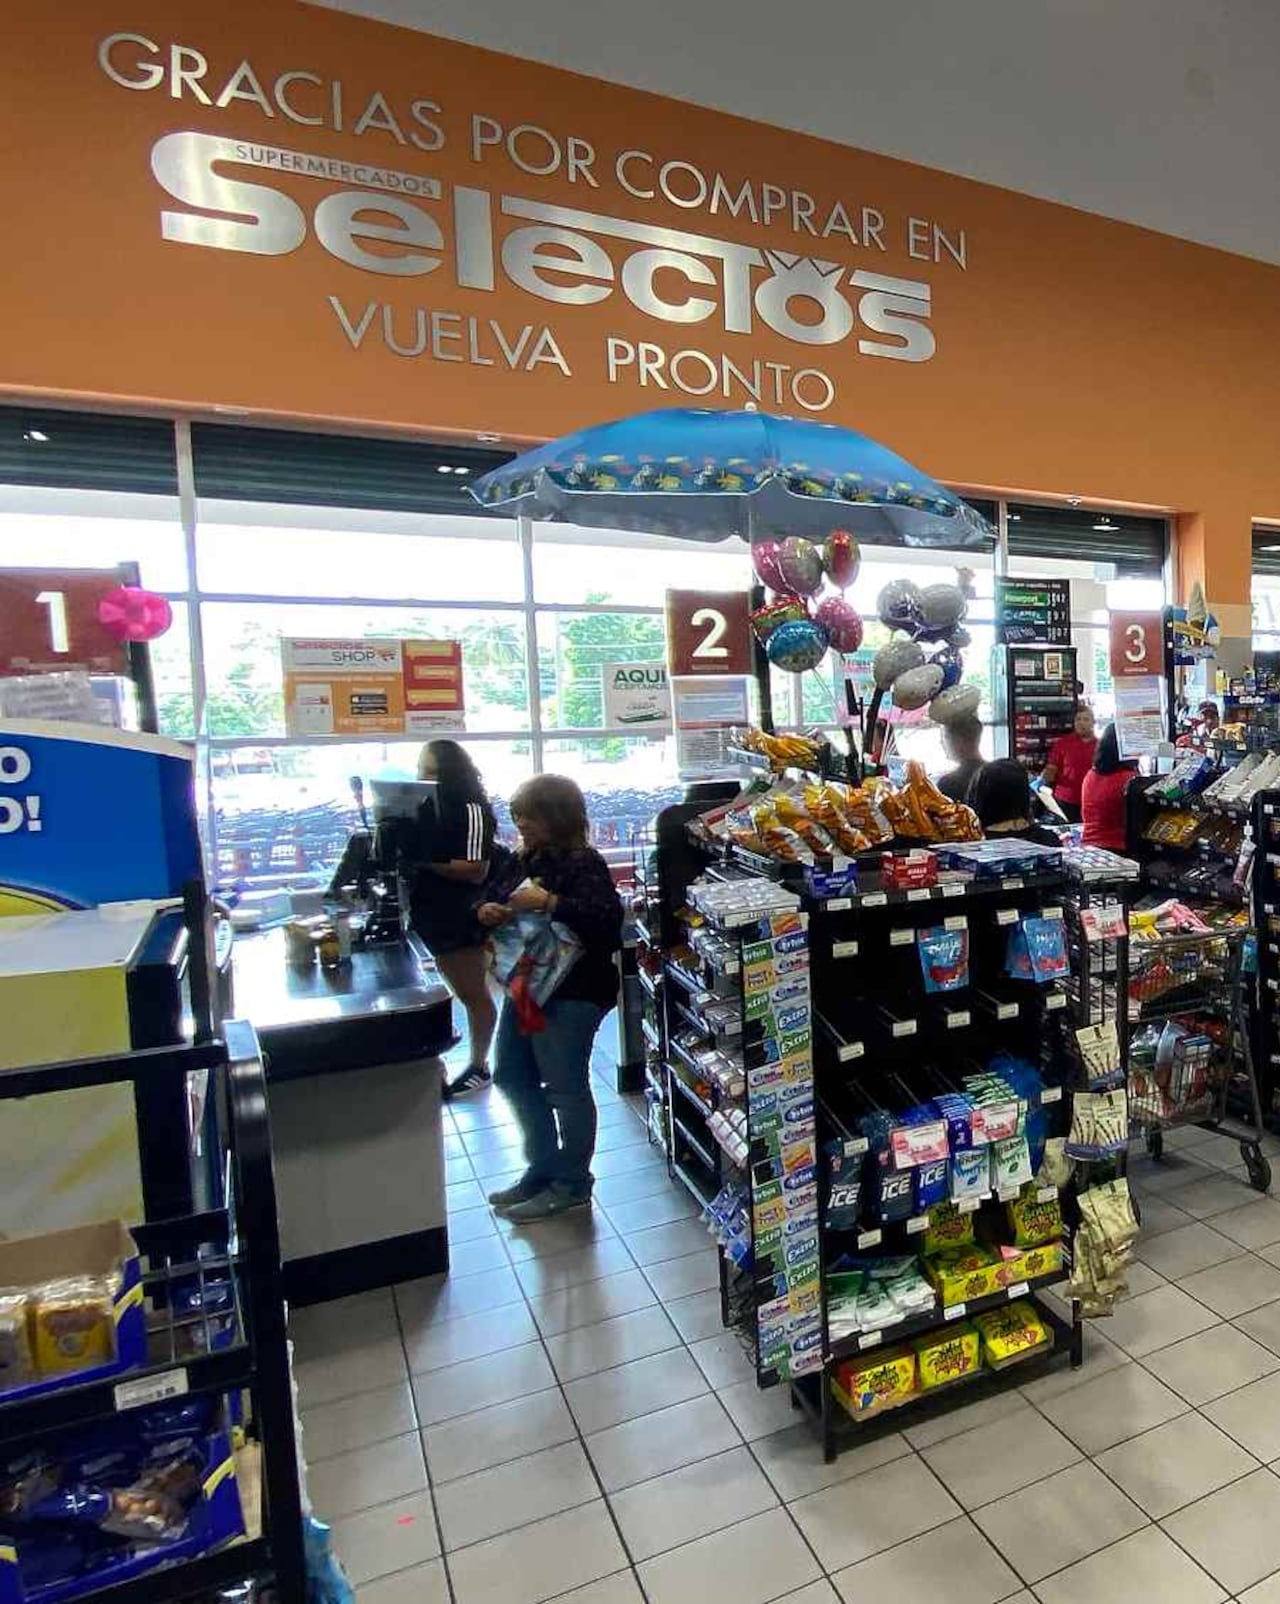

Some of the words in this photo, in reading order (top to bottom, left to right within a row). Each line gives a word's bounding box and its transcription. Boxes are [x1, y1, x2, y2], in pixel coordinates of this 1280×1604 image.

[97, 32, 446, 152] GRACIAS
[470, 113, 599, 188] POR
[614, 149, 887, 252] COMPRAR
[907, 215, 968, 271] EN
[234, 143, 435, 196] SUPERMERCADOS
[150, 131, 936, 363] Selectos
[328, 295, 571, 378] VUELVA
[606, 337, 836, 412] PRONTO
[35, 591, 69, 653] 1
[691, 608, 728, 657] 2
[1125, 624, 1149, 663] 3
[332, 650, 375, 662] SHOP
[614, 669, 666, 683] AQUI
[781, 1031, 809, 1054] Extra
